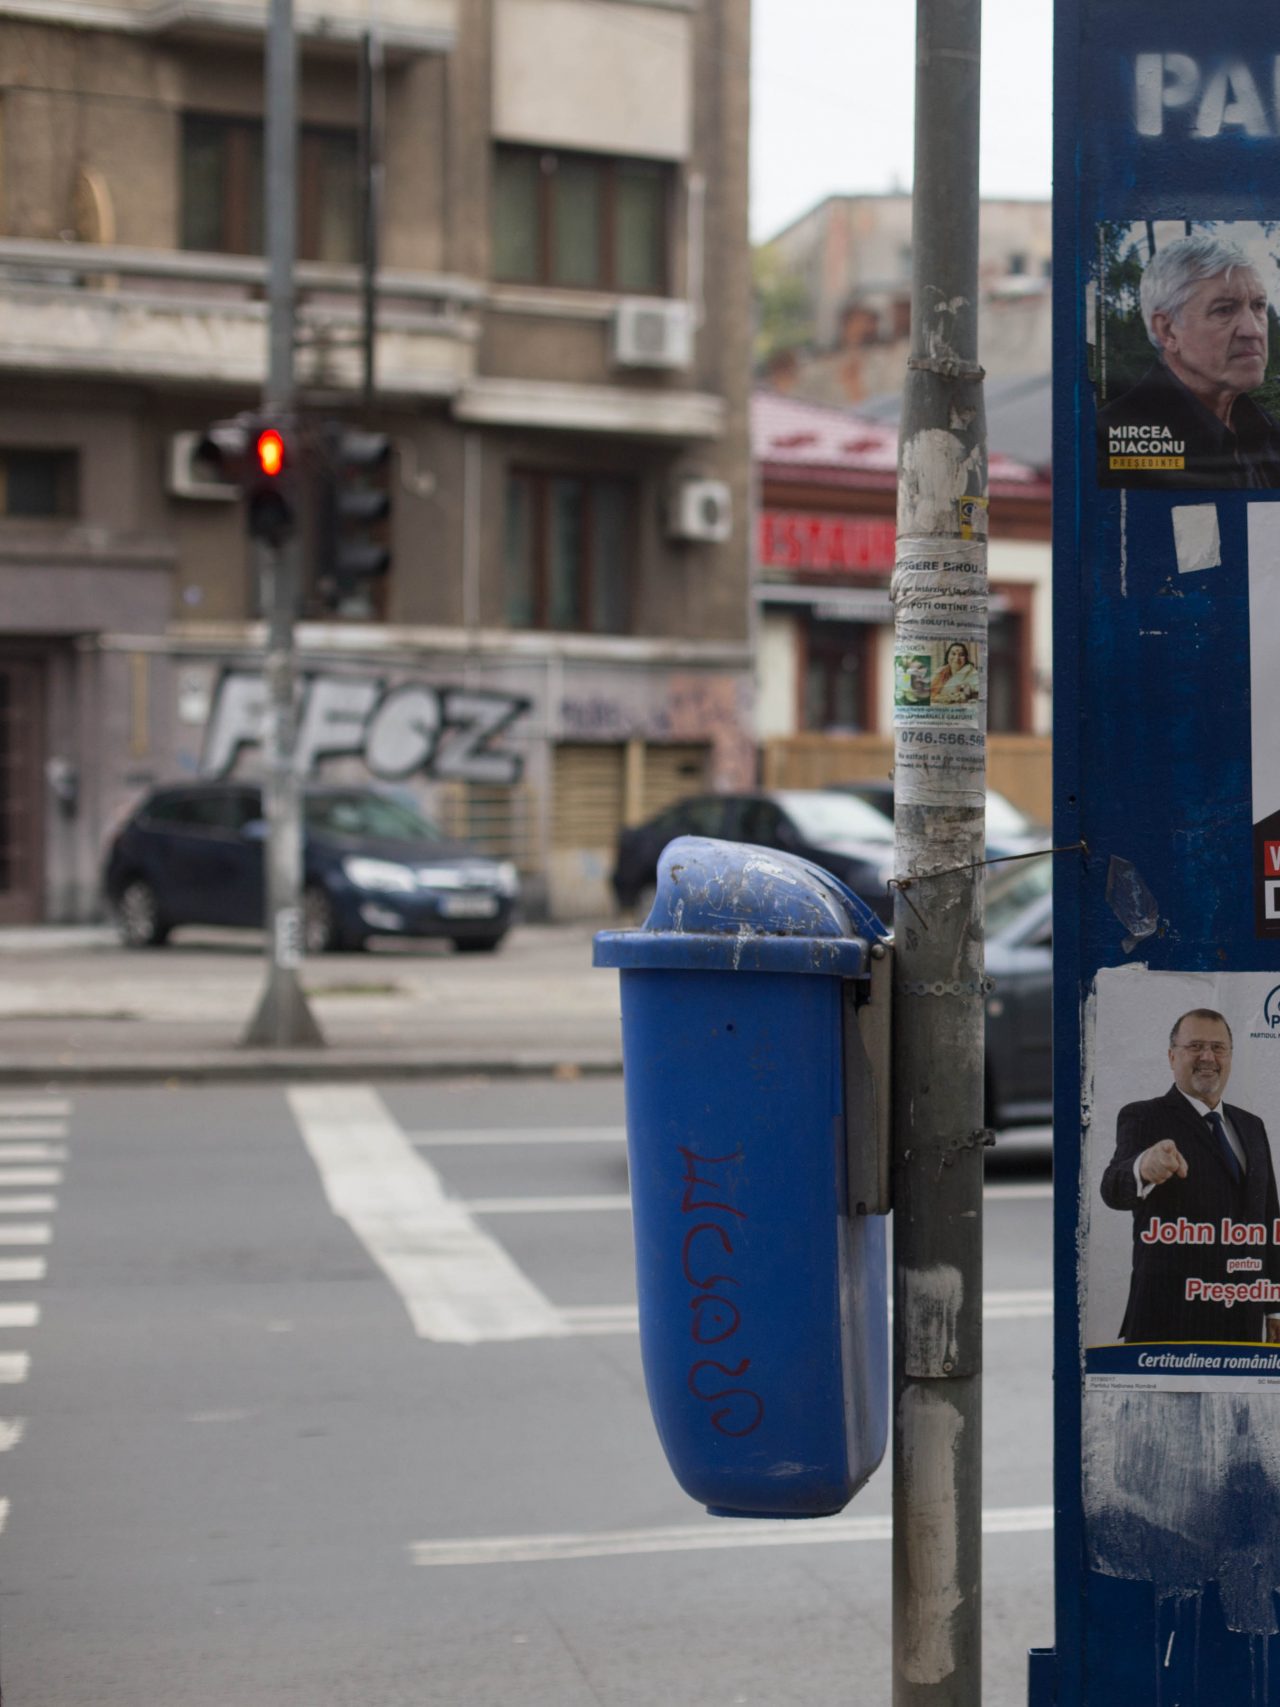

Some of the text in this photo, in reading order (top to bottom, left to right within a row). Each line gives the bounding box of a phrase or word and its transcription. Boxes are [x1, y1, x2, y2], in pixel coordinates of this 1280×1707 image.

[1109, 426, 1173, 439] MIRCEA
[1109, 441, 1185, 454] DIACONU
[1141, 1218, 1214, 1244] John
[1221, 1218, 1265, 1244] Ion
[1227, 1257, 1262, 1273] pentru
[1137, 1352, 1220, 1369] Certitudinea
